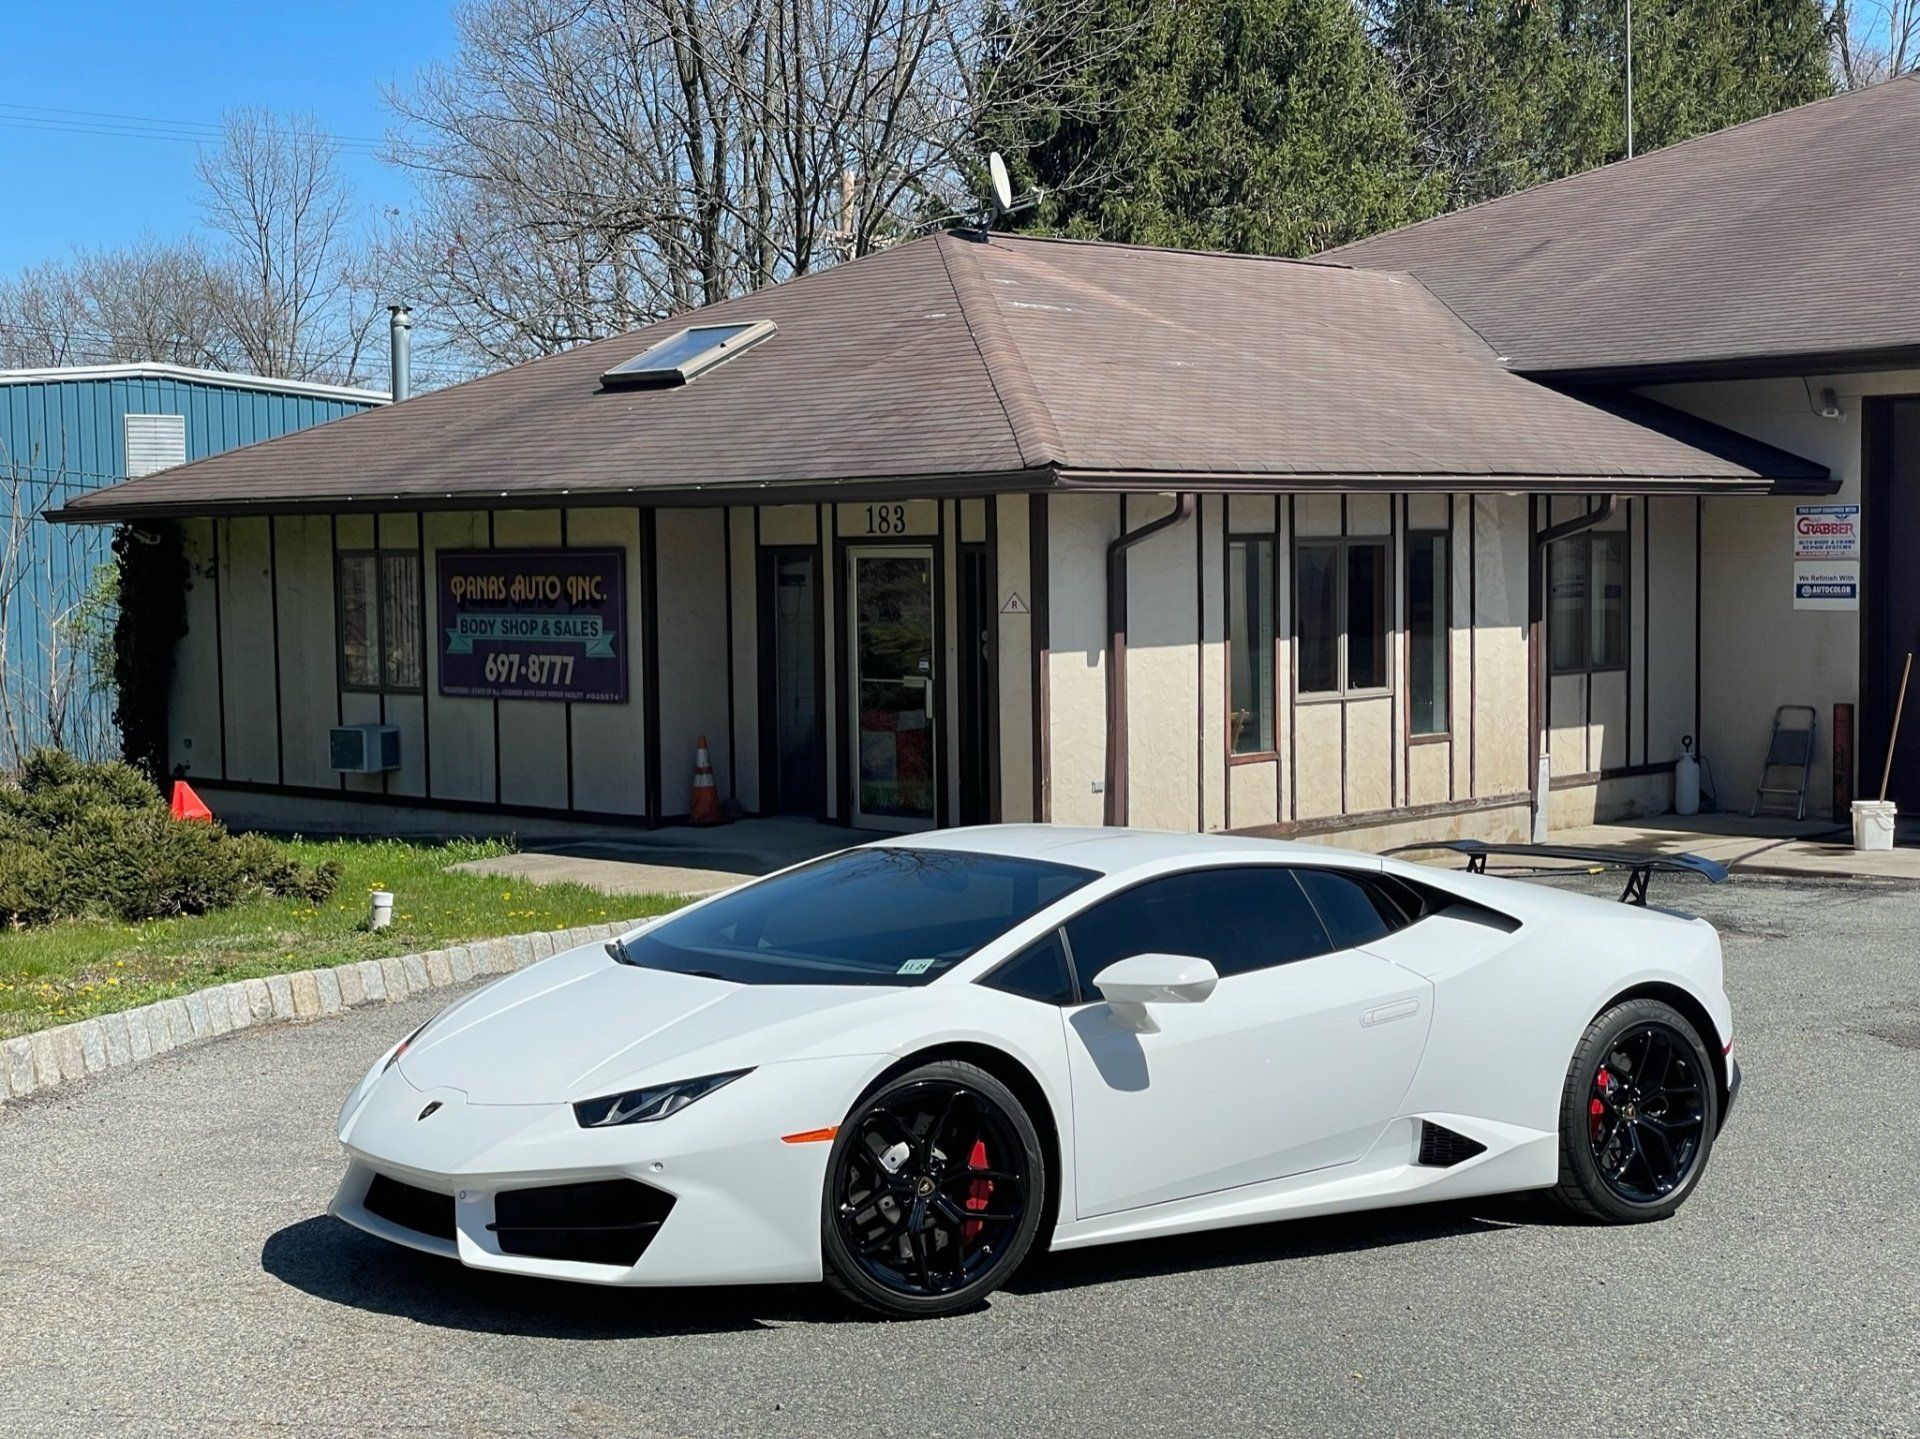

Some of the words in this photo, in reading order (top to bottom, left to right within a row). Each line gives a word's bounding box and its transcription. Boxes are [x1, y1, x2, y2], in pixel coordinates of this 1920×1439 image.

[865, 504, 906, 534] 183
[1797, 517, 1856, 538] GRABBER
[450, 575, 506, 604] PANAS
[510, 574, 561, 603] AUTO
[566, 575, 607, 605] INC.
[1812, 585, 1852, 593] AUTOCOLOR
[1011, 601, 1018, 609] R
[460, 618, 496, 634] BODY
[501, 619, 538, 636] SHOP
[541, 619, 551, 636] &
[554, 619, 598, 637] SALES
